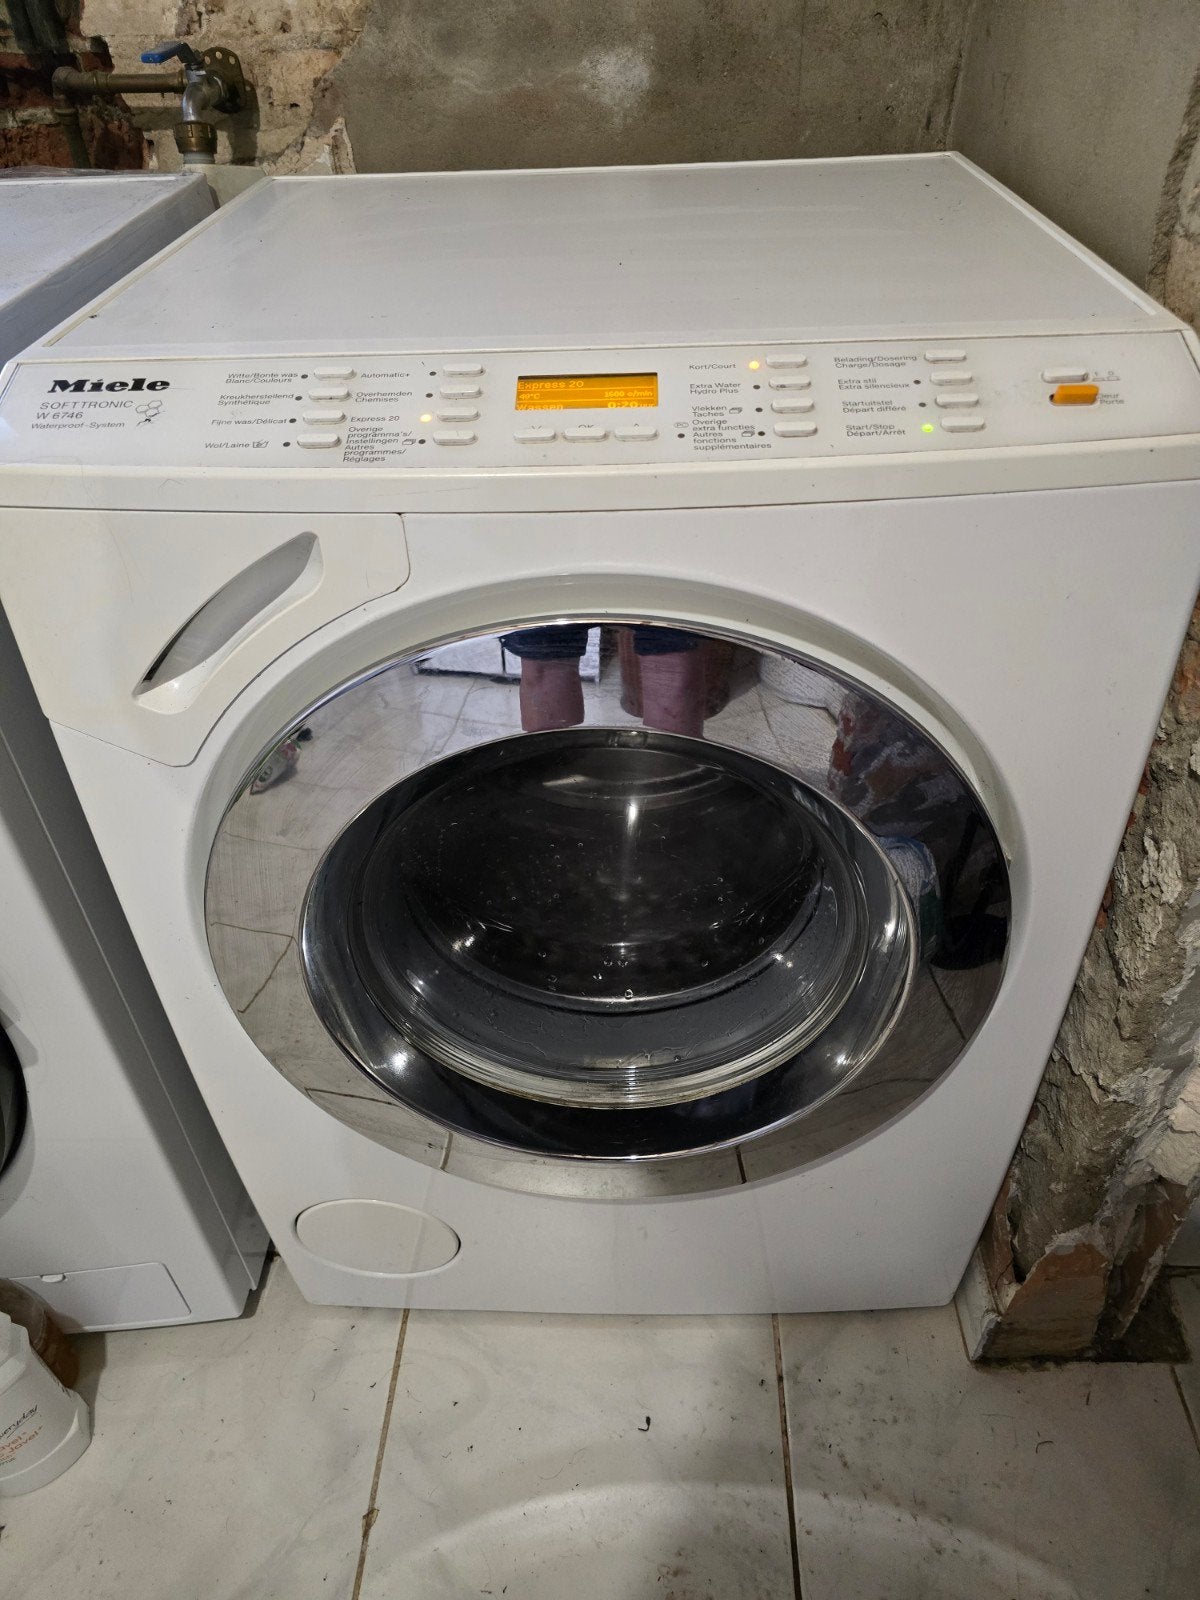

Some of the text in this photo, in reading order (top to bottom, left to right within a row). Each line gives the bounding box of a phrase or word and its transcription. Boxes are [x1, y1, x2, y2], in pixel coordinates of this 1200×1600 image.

[47, 378, 171, 393] Miele
[518, 380, 584, 390] Express 20
[40, 400, 132, 410] SOFTTRONIC
[607, 400, 639, 409] 0:20
[52, 412, 84, 420] 6746
[344, 448, 406, 456] programmes/
